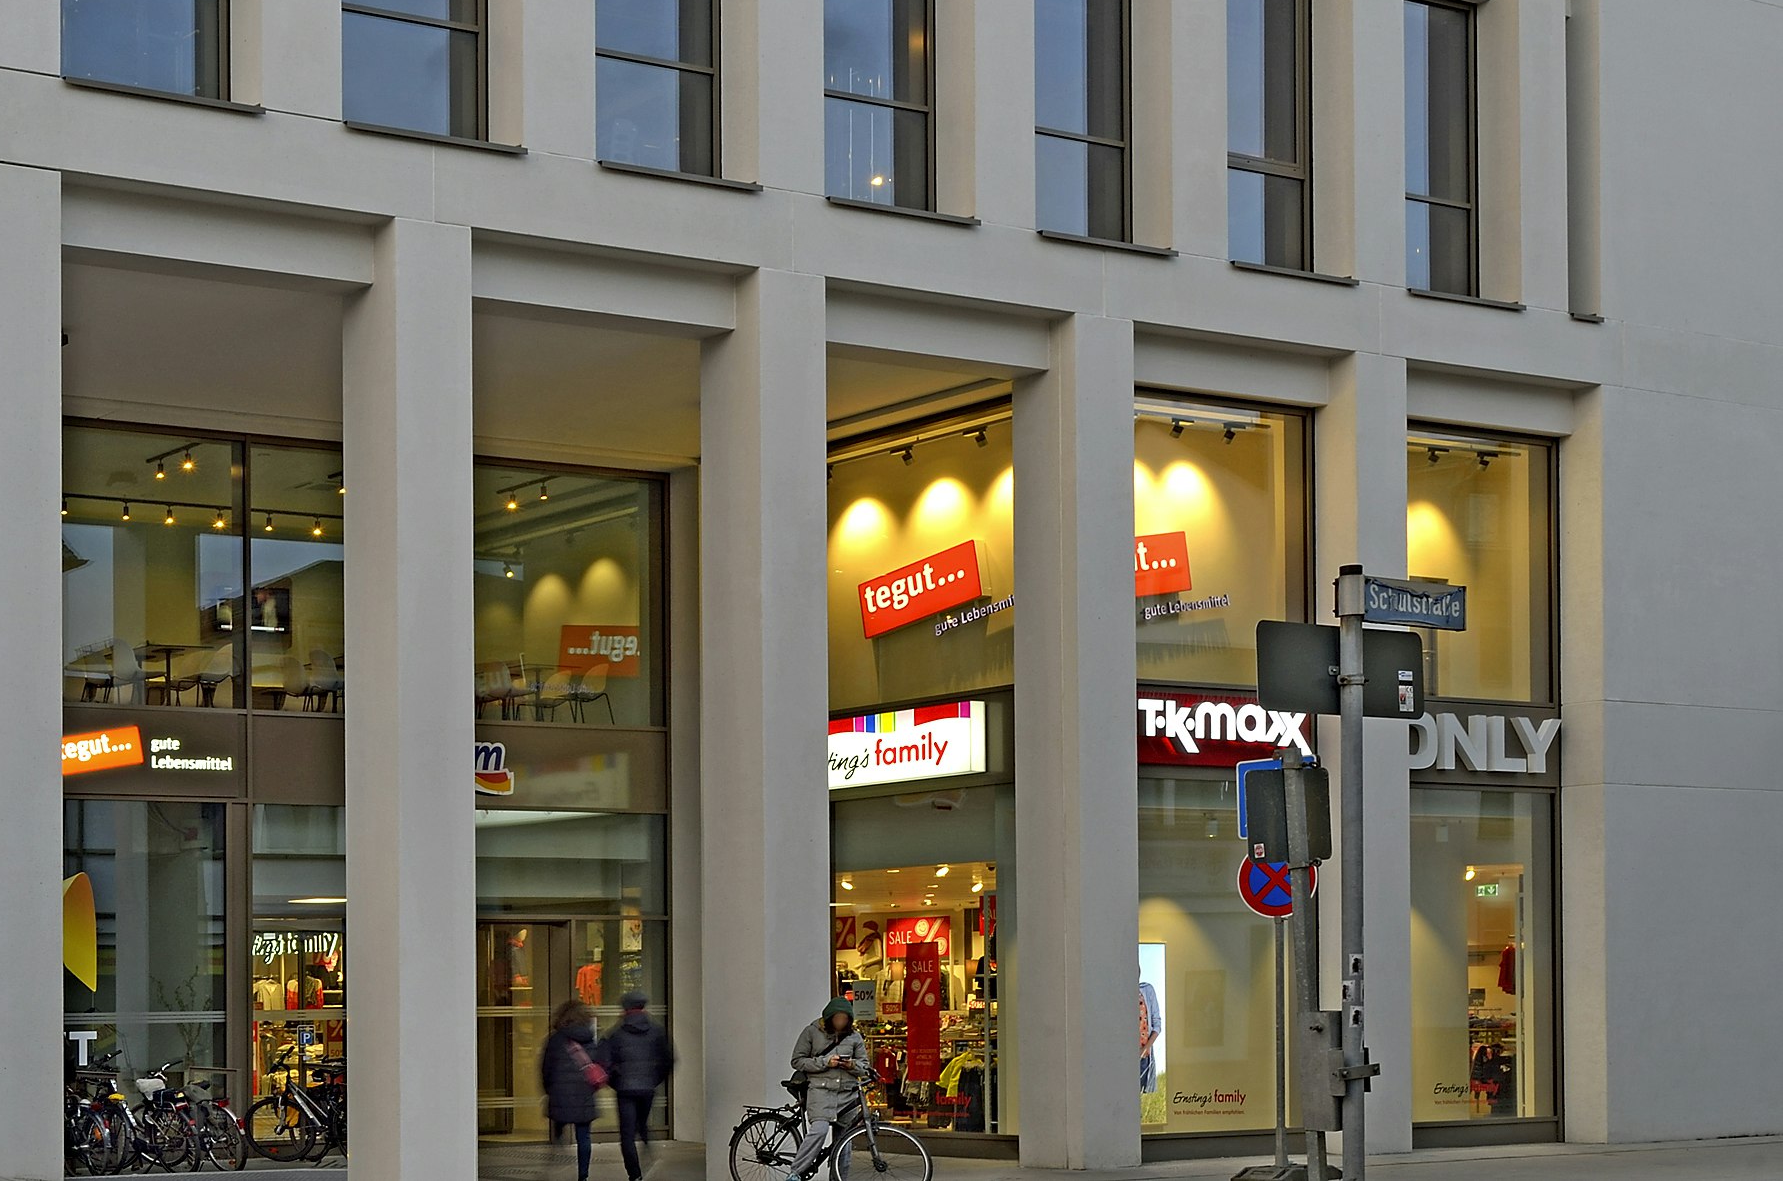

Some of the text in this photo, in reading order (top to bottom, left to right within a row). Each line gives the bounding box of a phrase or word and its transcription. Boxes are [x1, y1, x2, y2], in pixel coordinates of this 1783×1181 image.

[1135, 541, 1176, 572] t...
[864, 562, 965, 614] tegut...
[1144, 594, 1231, 620] gute Lebensmittel
[934, 616, 959, 636] gute
[150, 737, 181, 753] gute
[875, 731, 948, 766] family
[151, 755, 233, 771] Lebensmittel
[888, 931, 913, 945] SALE
[911, 960, 934, 973] SALE
[854, 990, 874, 1001] 50%
[1173, 1089, 1246, 1107] Ernsting's family
